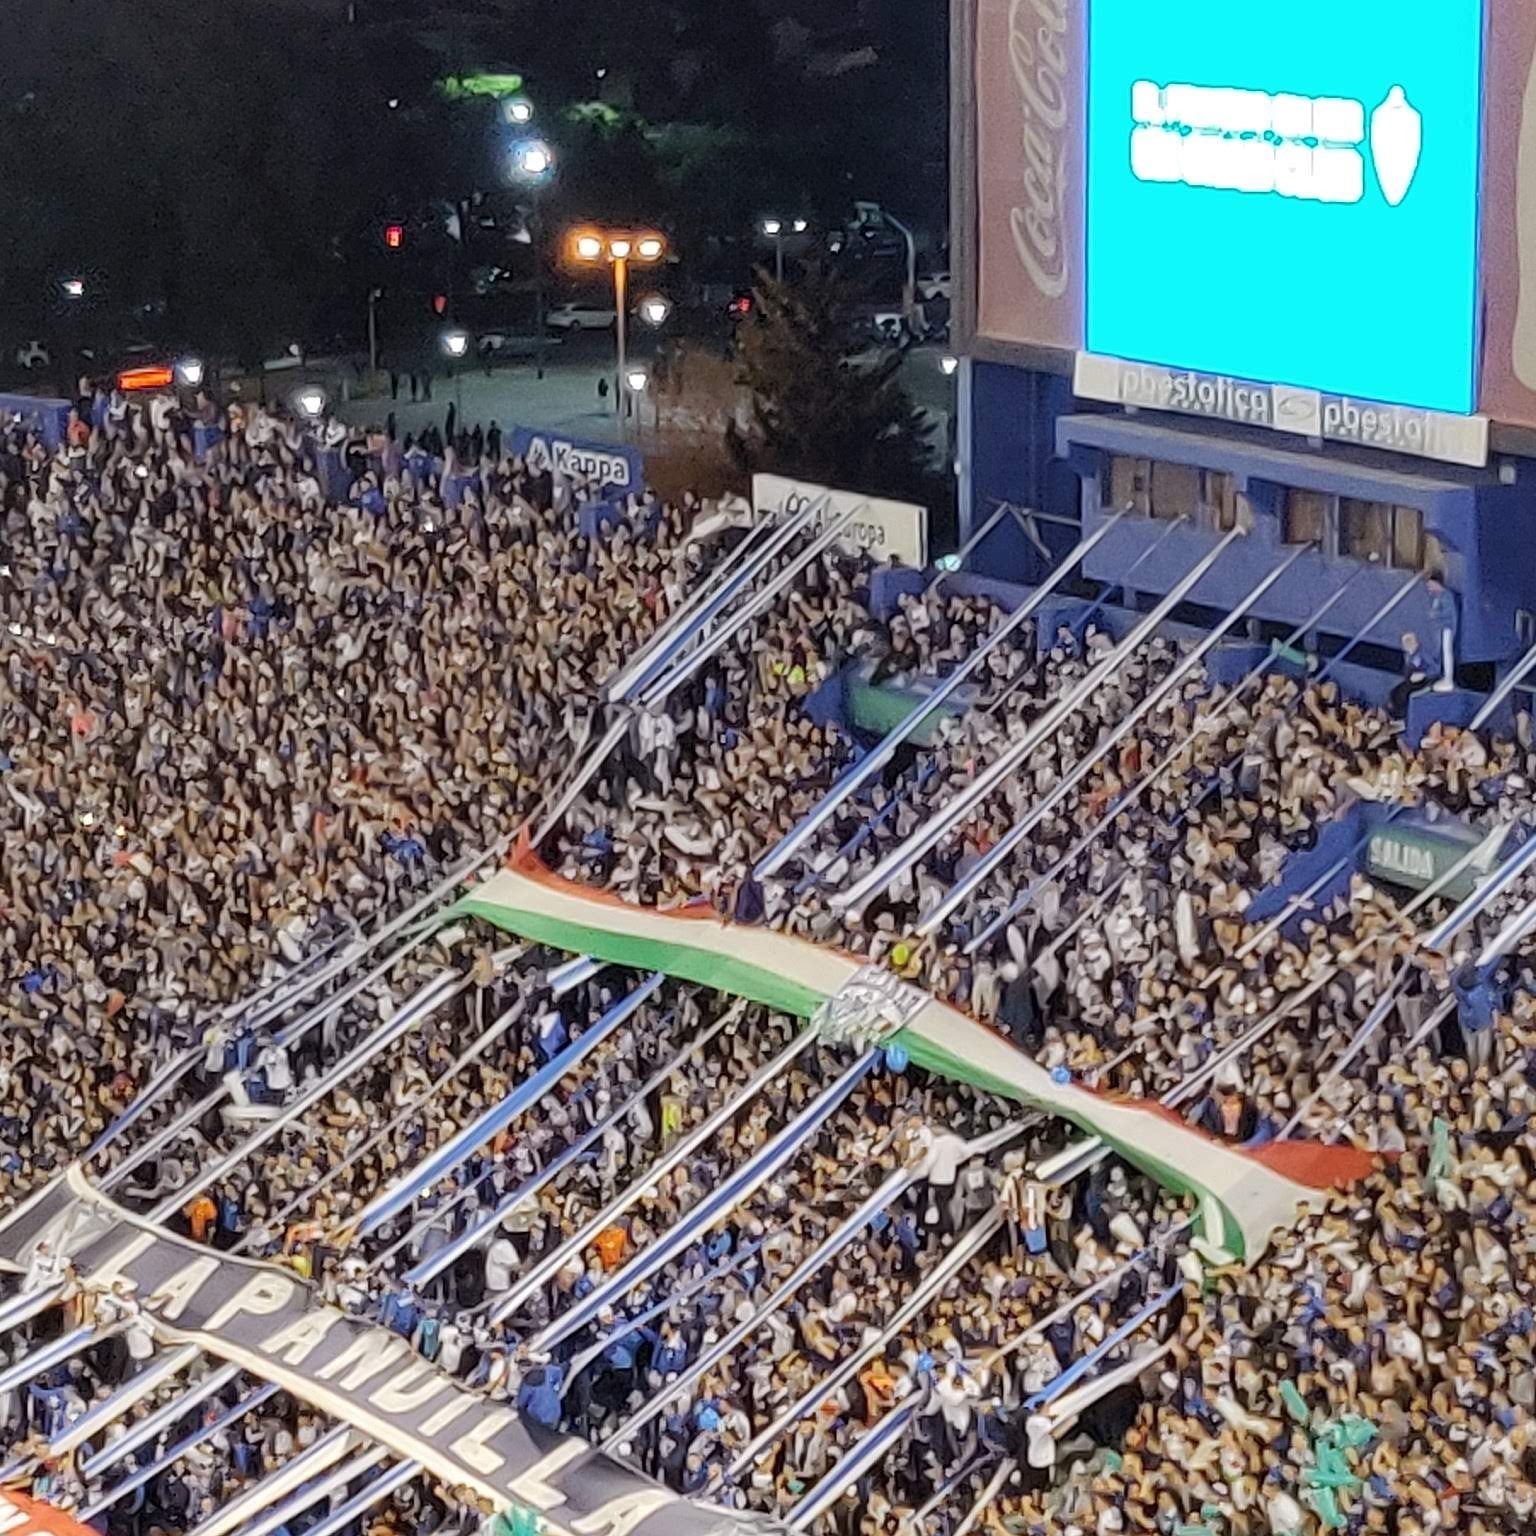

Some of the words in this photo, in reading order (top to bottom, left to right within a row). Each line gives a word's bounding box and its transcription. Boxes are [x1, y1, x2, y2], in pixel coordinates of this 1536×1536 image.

[554, 443, 627, 483] Kappa
[1370, 836, 1434, 880] SALIDA
[80, 1231, 222, 1322] LA
